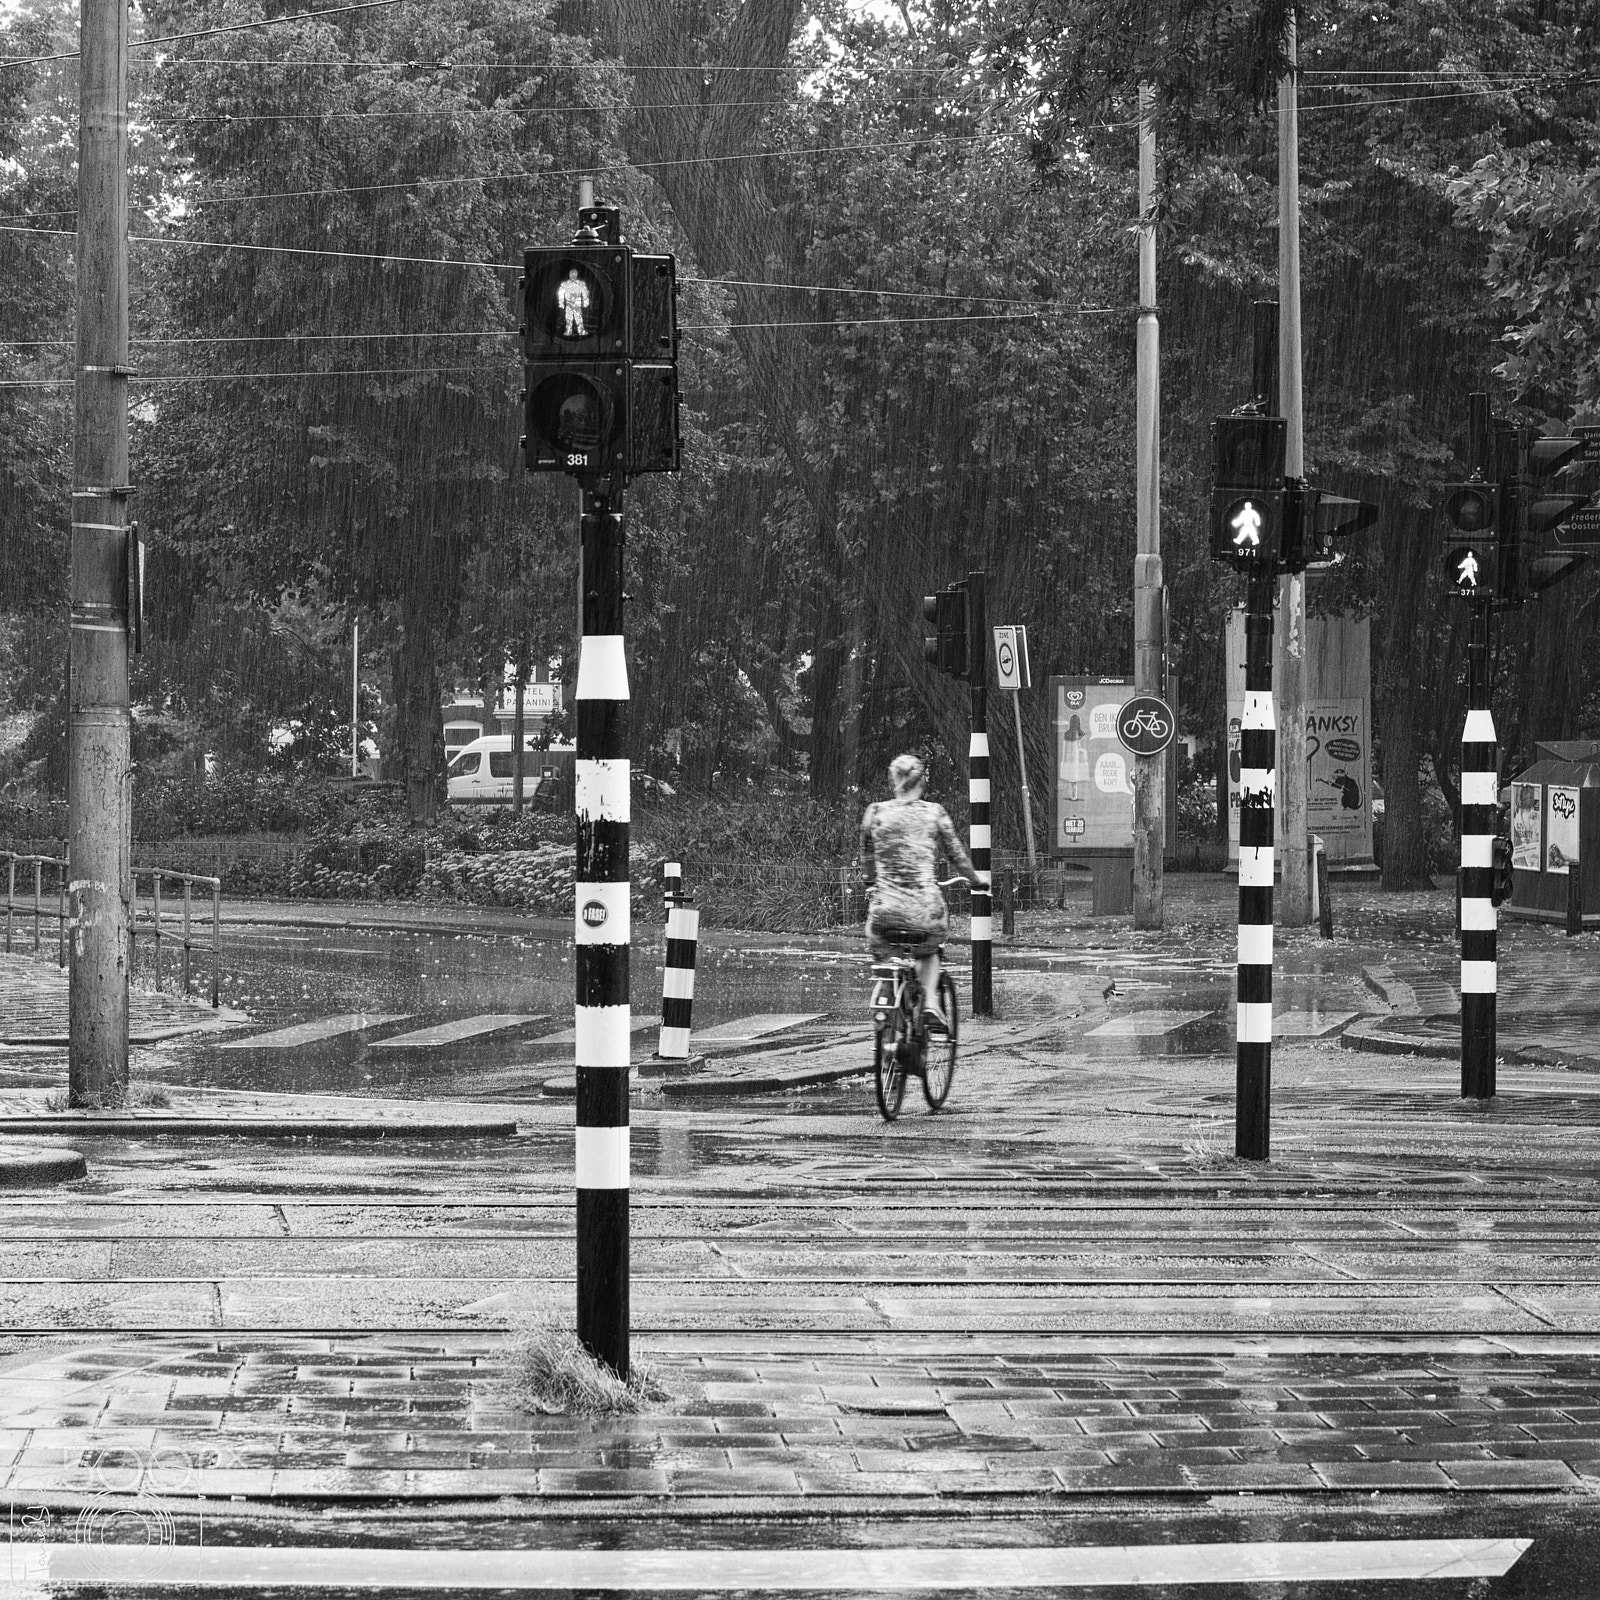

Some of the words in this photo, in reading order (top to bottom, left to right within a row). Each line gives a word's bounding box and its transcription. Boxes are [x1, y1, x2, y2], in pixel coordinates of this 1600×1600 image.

[567, 454, 588, 466] 381
[1238, 548, 1256, 557] 971
[1460, 588, 1475, 596] 371
[513, 687, 544, 696] HTEL
[506, 698, 551, 706] PAANINI
[1094, 712, 1108, 723] BEN
[1305, 714, 1358, 734] ANKSY
